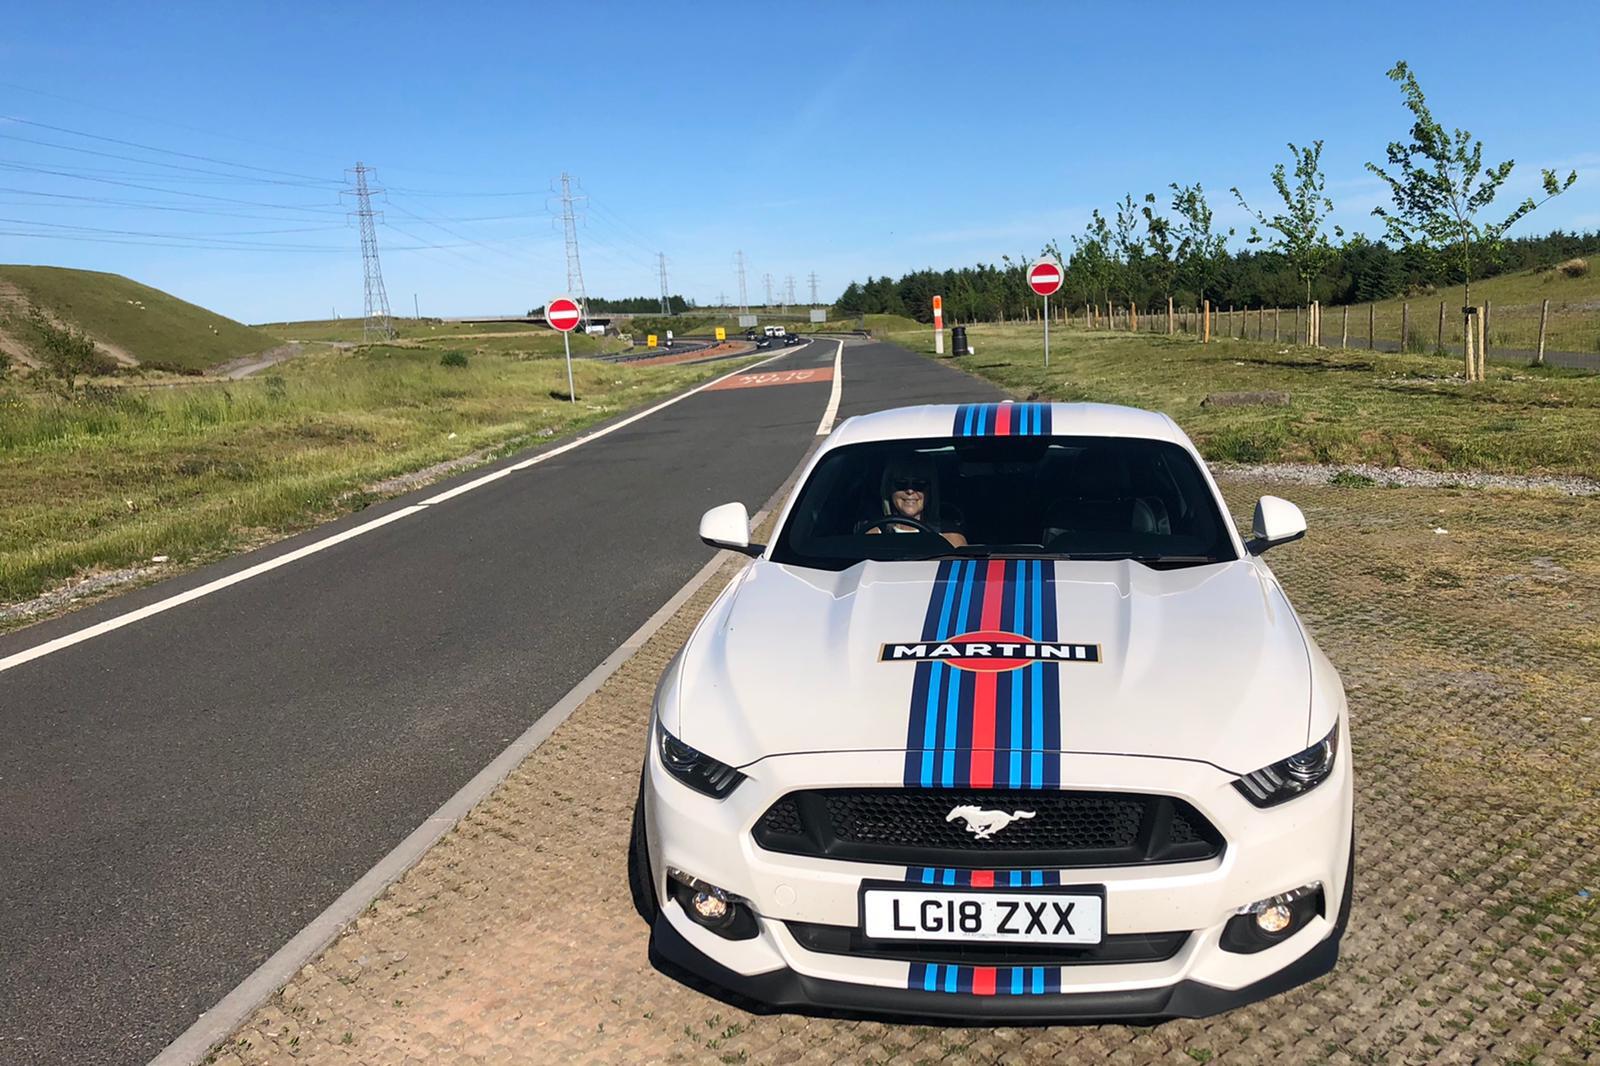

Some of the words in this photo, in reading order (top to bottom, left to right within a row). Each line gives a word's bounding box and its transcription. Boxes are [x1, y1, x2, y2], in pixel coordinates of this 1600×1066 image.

[892, 643, 1088, 659] MARTINI
[893, 899, 982, 933] LG18
[996, 901, 1075, 935] ZXX
